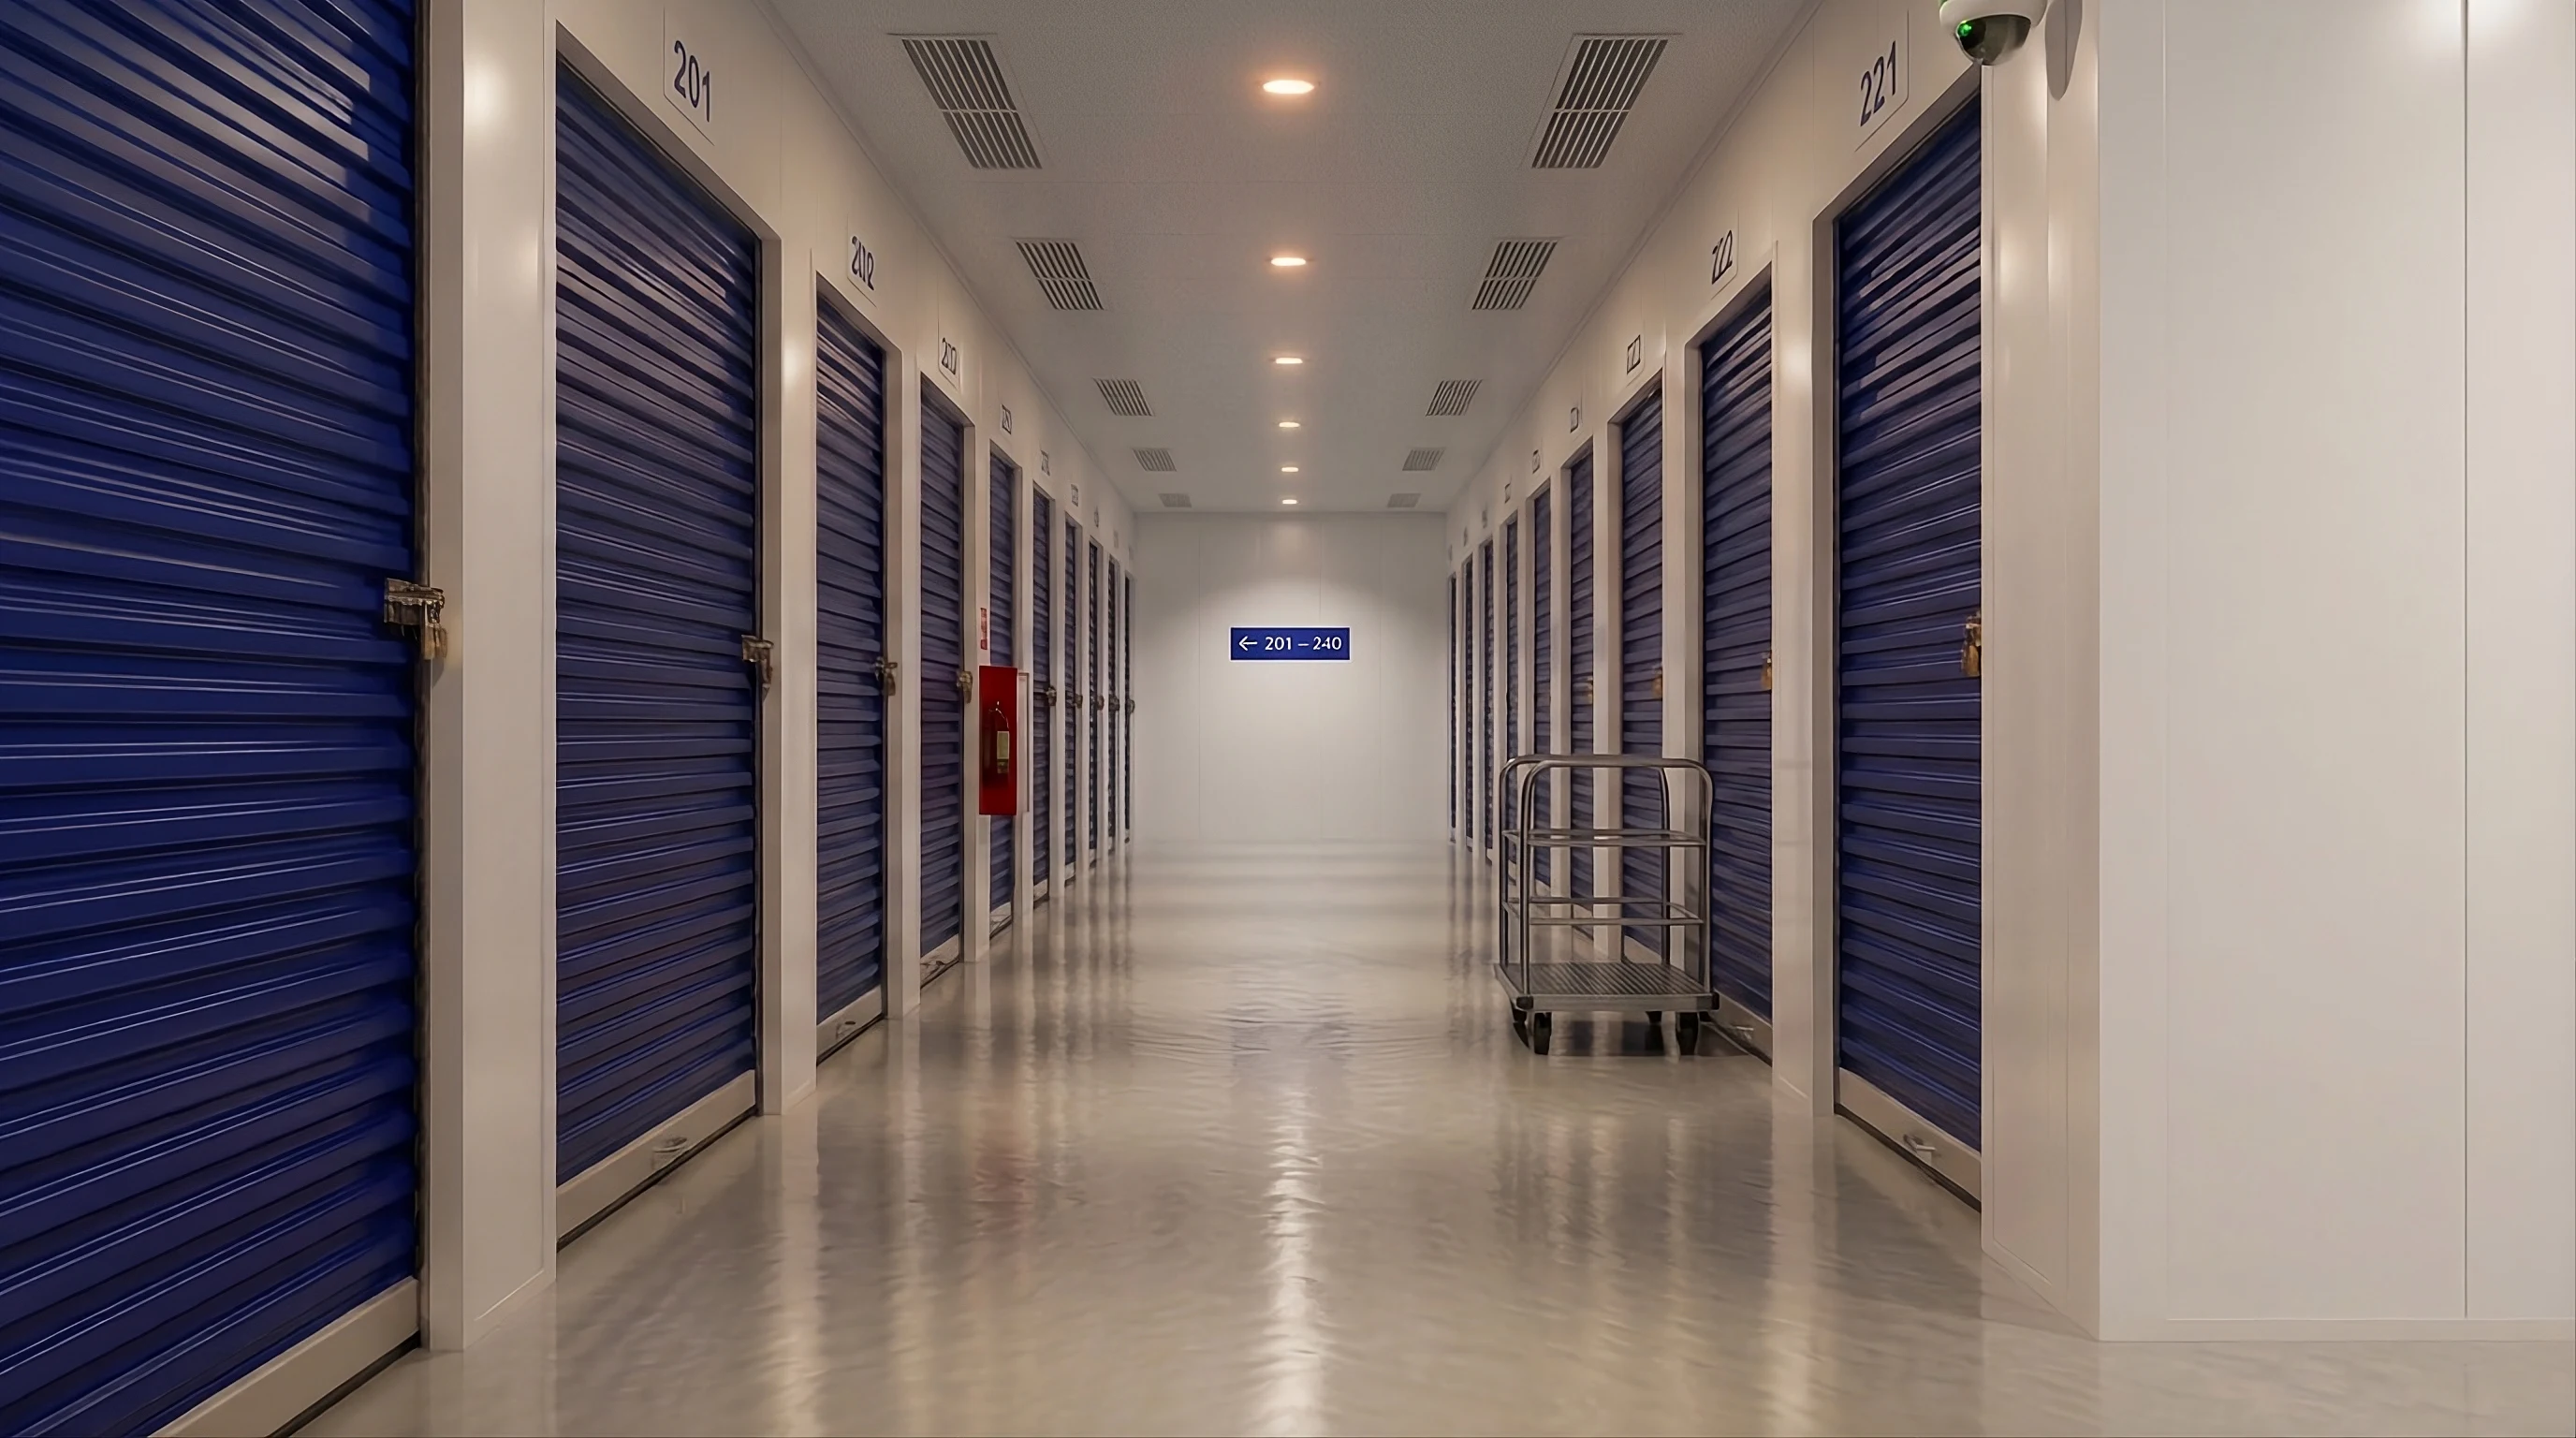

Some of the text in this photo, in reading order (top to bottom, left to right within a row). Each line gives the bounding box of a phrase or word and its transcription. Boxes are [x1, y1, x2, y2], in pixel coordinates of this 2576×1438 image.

[673, 39, 710, 123] 201
[1859, 40, 1896, 127] 221
[1265, 637, 1292, 651] 201
[1312, 637, 1342, 651] 240
